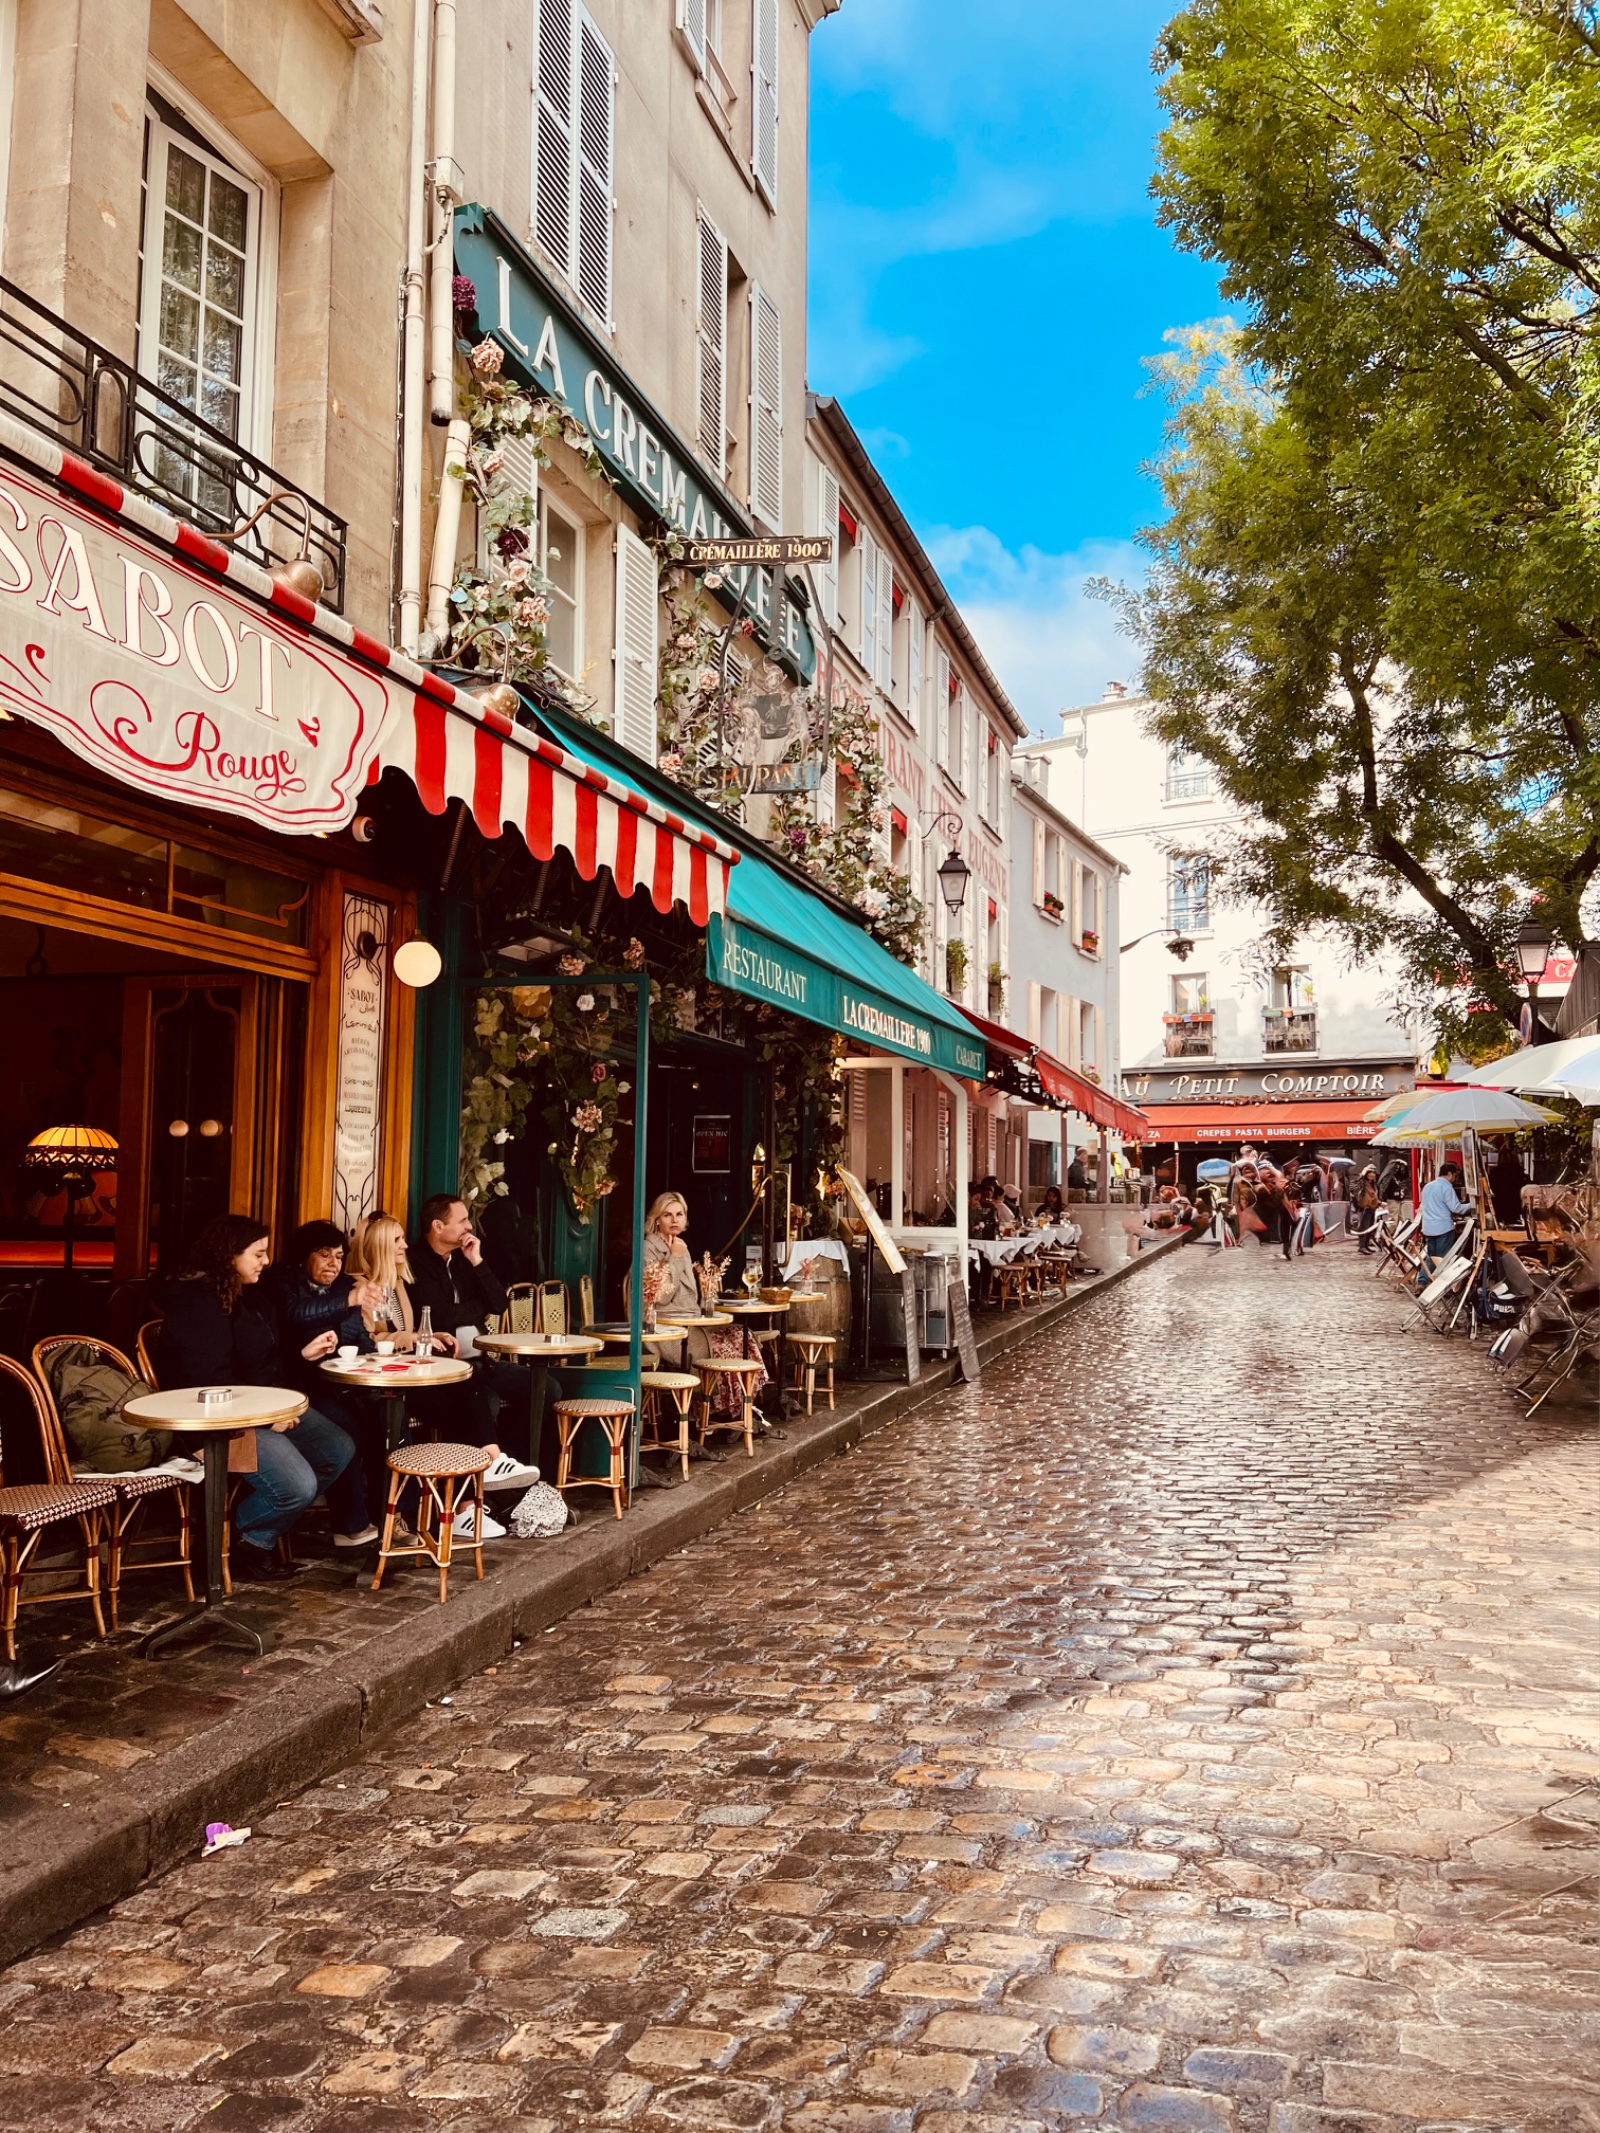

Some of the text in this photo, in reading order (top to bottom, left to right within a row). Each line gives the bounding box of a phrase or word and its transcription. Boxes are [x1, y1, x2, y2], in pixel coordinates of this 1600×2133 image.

[496, 256, 801, 662] LA CREMALLEE
[690, 542, 781, 561] CRÉMAILLÈRE
[0, 487, 292, 722] SABOT
[723, 940, 807, 1003] RESTAURANT
[843, 995, 931, 1056] LA CREMAILLERE 1900
[1196, 1127, 1311, 1137] CREPES PASTA BURGERS
[1346, 1124, 1376, 1135] BIÈRE
